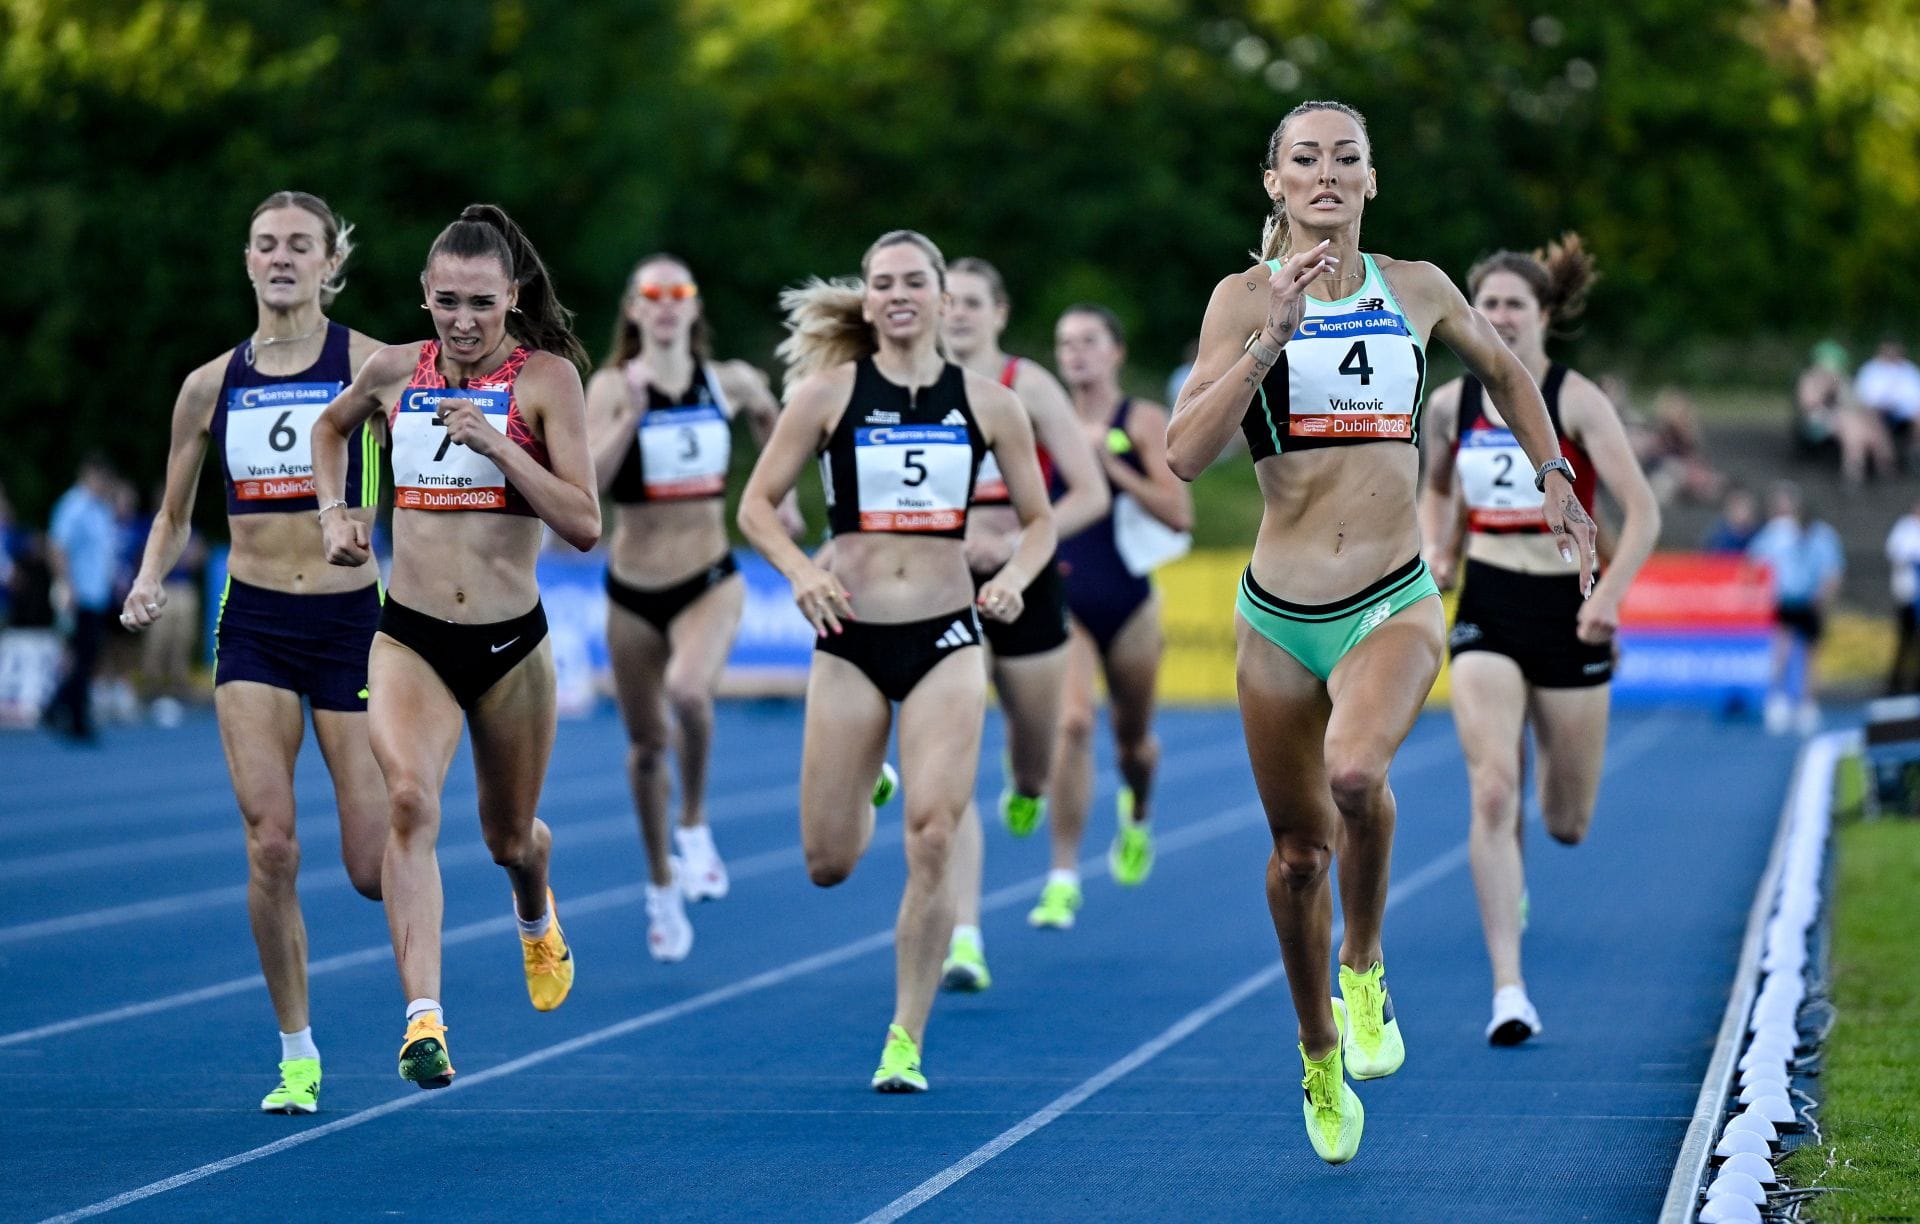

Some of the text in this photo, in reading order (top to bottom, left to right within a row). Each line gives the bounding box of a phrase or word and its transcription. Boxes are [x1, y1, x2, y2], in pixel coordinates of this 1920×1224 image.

[1319, 318, 1398, 332] MORTON GAMES
[1338, 340, 1374, 386] 4
[258, 389, 328, 402] MORTON GAMES
[1329, 398, 1384, 411] Vukovic
[269, 411, 296, 452] 6
[1334, 418, 1404, 432] Dublin2026
[432, 417, 453, 462] 7
[679, 426, 699, 462] 3
[247, 464, 276, 477] Vans
[902, 450, 927, 487] 5
[1493, 454, 1514, 487] 2
[417, 472, 473, 487] Armitage
[423, 490, 496, 505] Dublin2026
